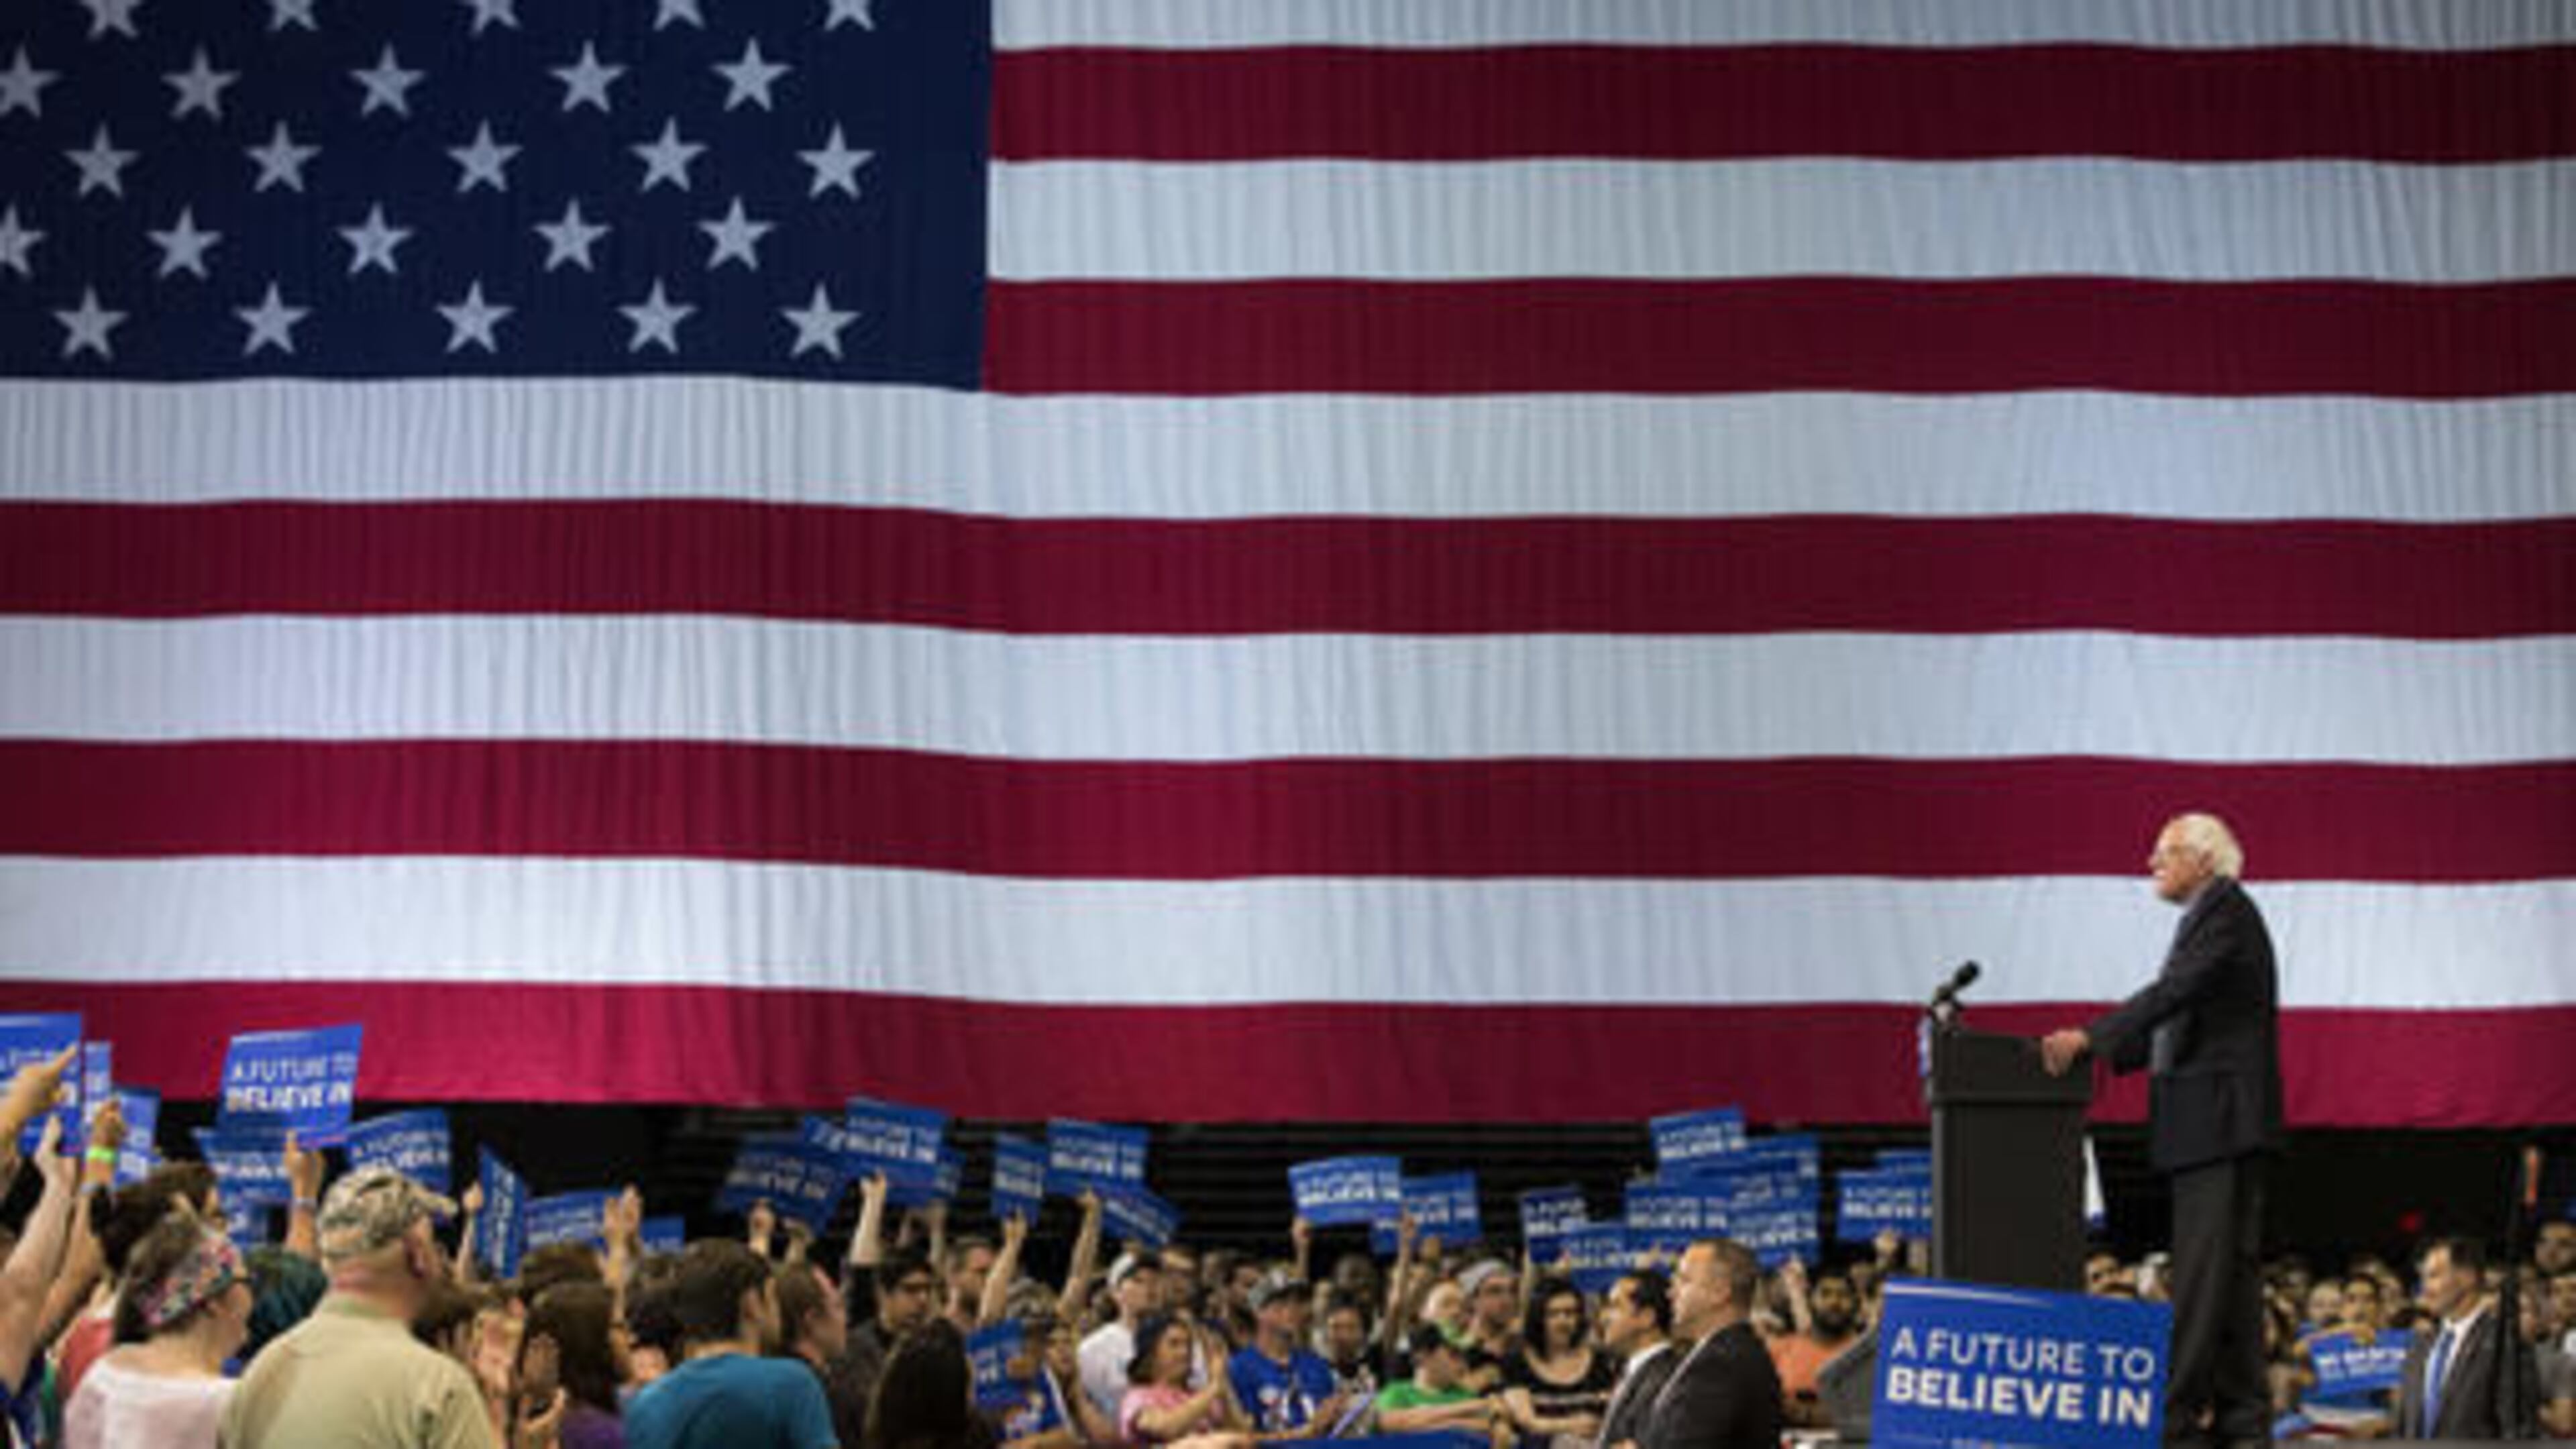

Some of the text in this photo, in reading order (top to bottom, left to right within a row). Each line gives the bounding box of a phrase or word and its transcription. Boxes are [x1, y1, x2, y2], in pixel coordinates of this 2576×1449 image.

[248, 1055, 327, 1083] FUTURE
[227, 1084, 323, 1112] BELIEVE
[1890, 1326, 2155, 1383] A FUTURE TO
[1886, 1366, 2152, 1428] BELIEVE IN
